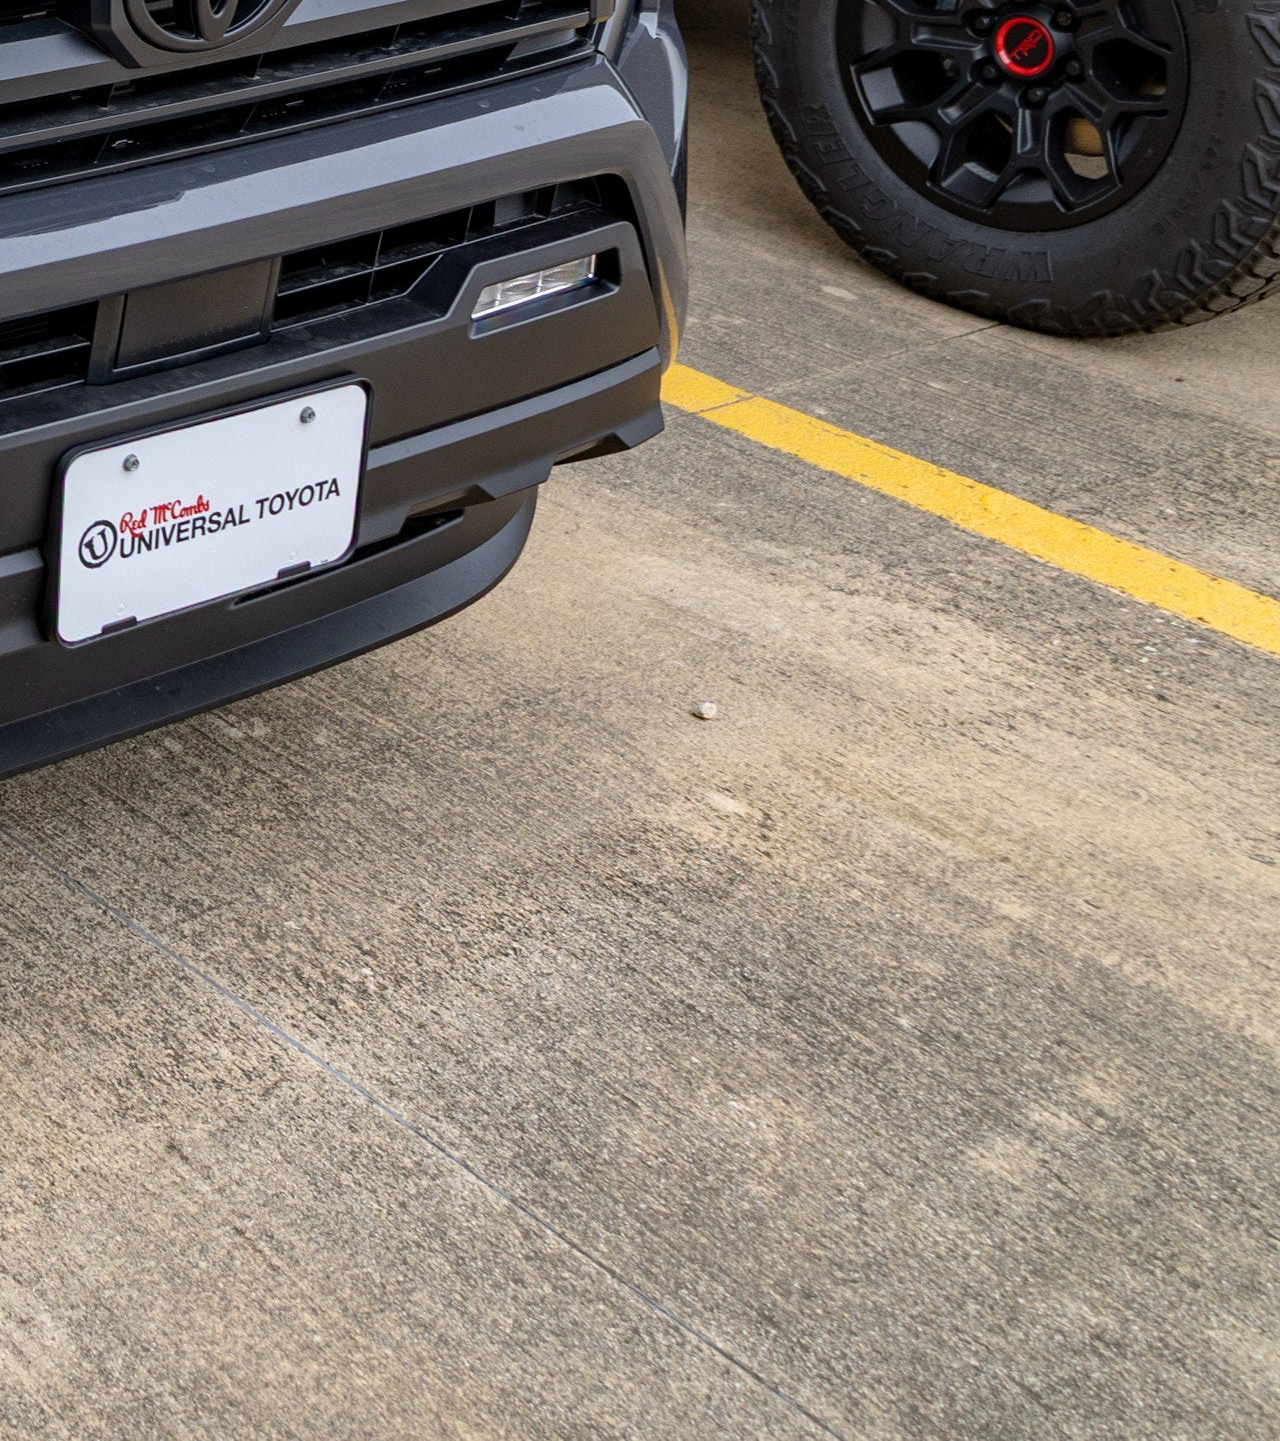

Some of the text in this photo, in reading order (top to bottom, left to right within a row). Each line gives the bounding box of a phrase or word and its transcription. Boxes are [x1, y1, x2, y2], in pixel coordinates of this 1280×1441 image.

[1010, 29, 1043, 60] TRD
[800, 103, 1054, 283] WRANGLER
[120, 477, 341, 559] UNIVERSAL TOYOTA
[120, 509, 148, 538] Red
